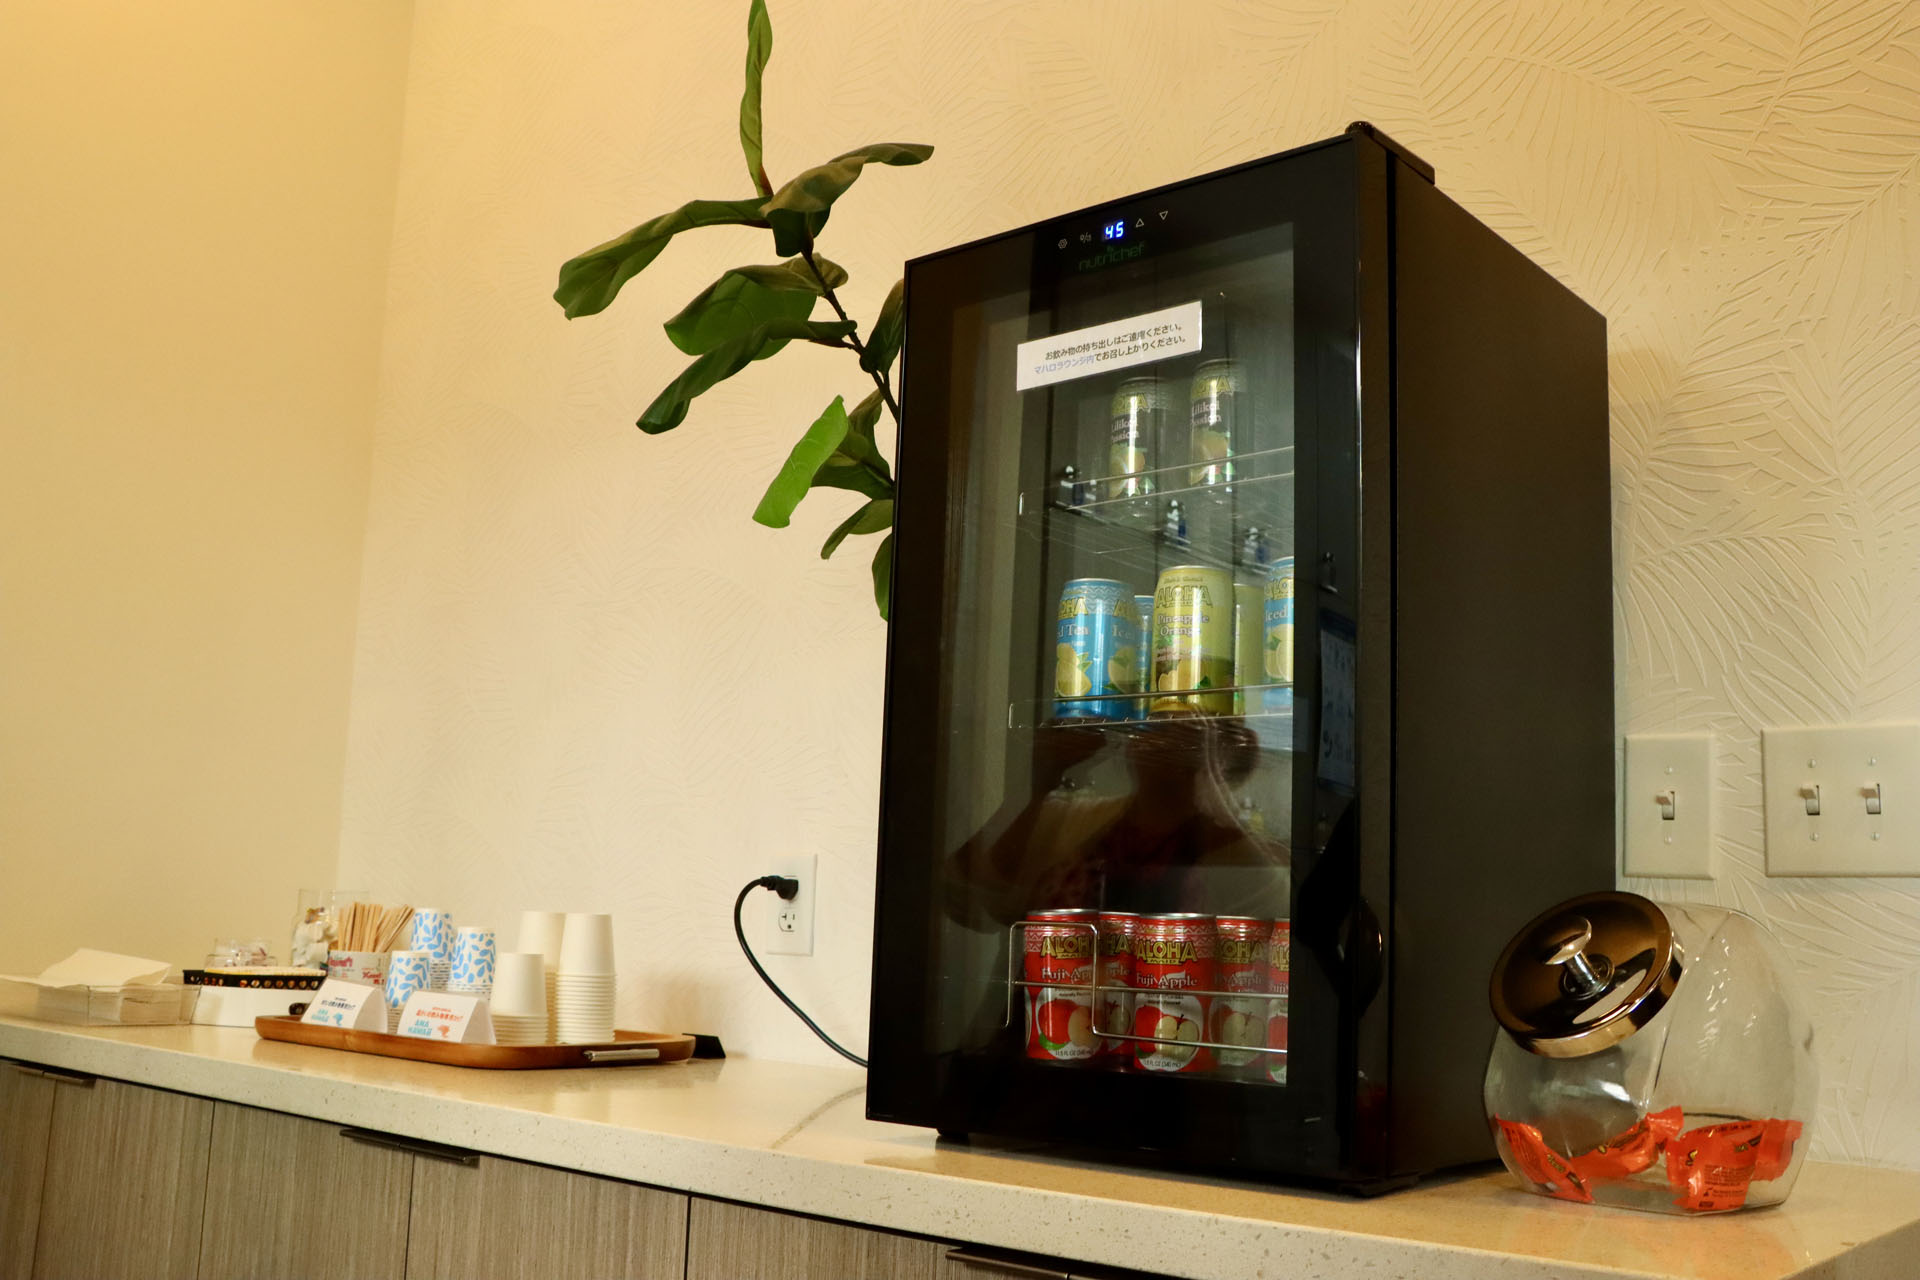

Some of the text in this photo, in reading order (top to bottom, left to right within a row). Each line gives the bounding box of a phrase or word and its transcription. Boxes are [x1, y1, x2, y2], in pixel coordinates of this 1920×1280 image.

[1104, 220, 1124, 239] 45
[1079, 241, 1145, 272] nutrichef
[1155, 585, 1213, 609] ALOHA
[1157, 611, 1210, 626] Pineappe
[1040, 935, 1094, 958] ALOH
[1135, 940, 1199, 962] ALOHA
[1136, 972, 1155, 987] Fuji
[1158, 974, 1198, 989] Apple
